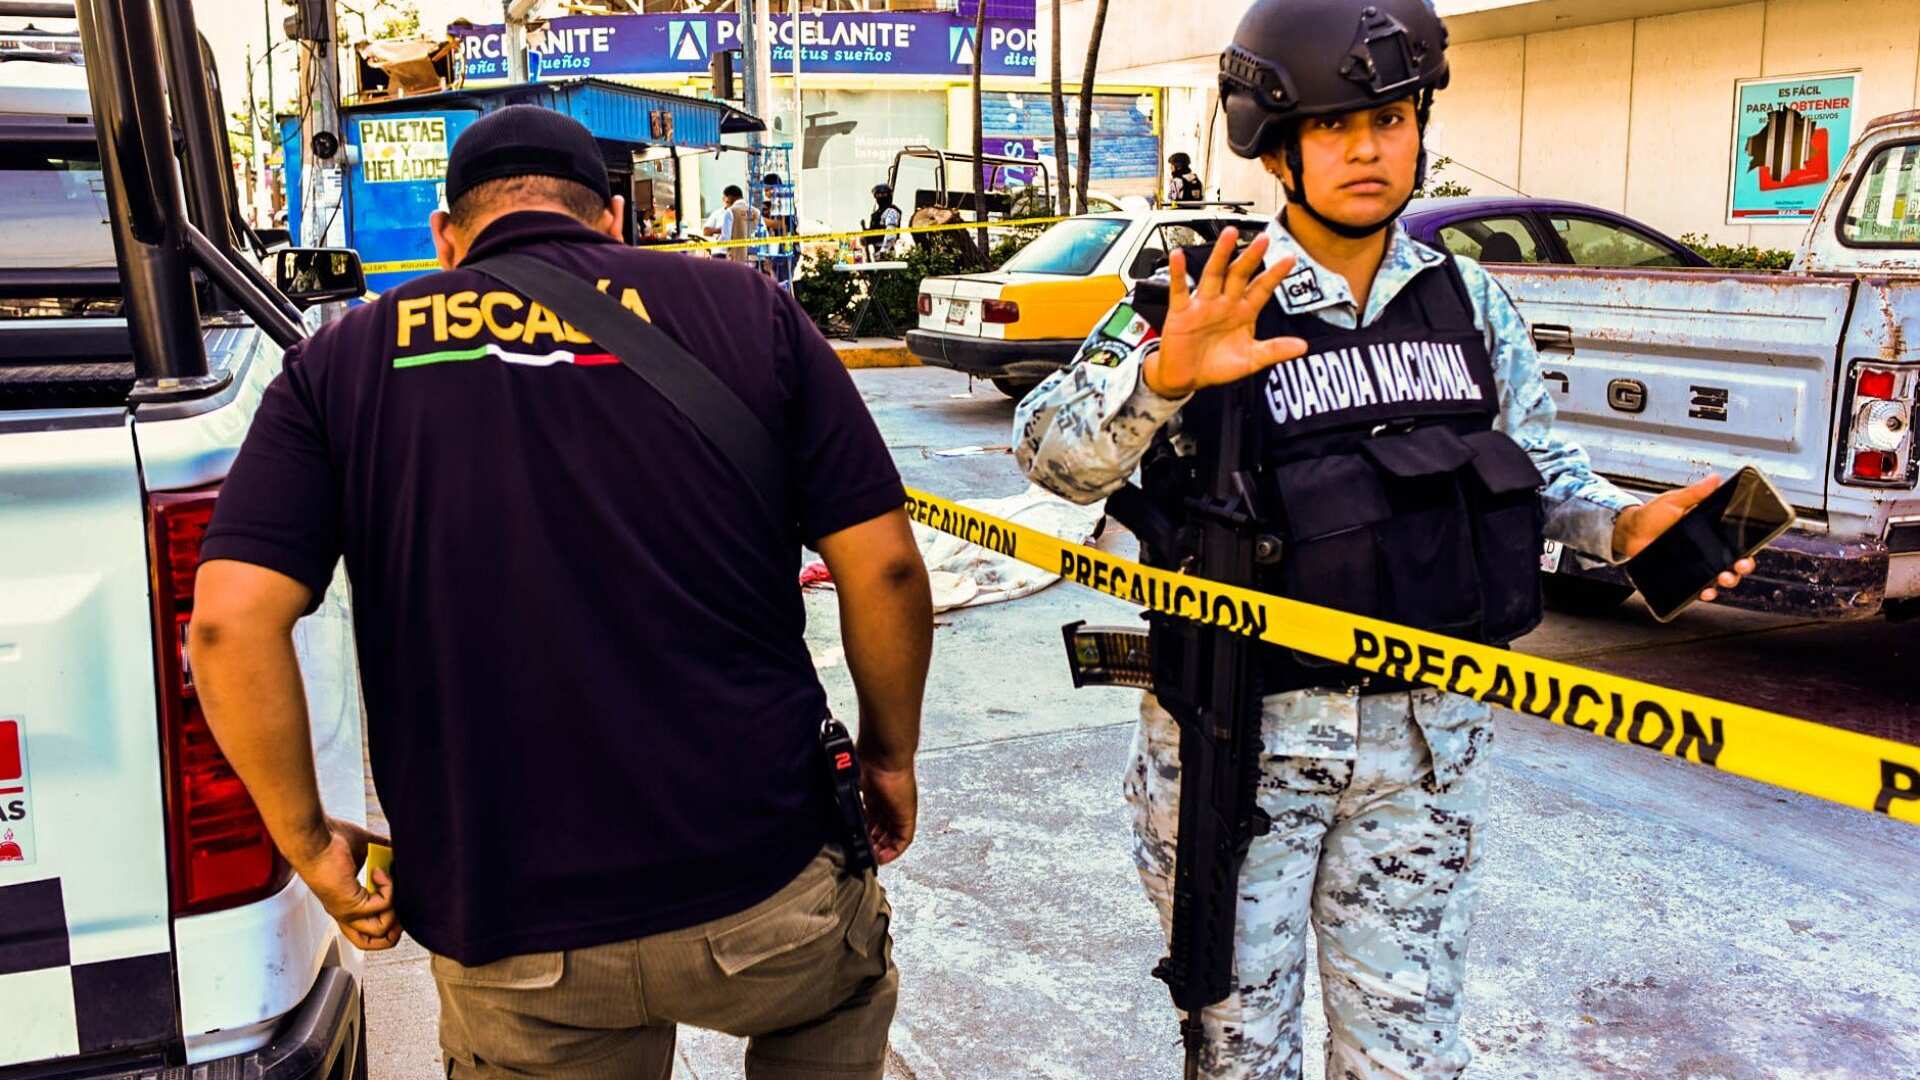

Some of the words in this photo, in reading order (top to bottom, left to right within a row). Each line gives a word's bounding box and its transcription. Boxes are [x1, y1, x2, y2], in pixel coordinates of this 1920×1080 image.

[834, 46, 892, 62] sueños
[1778, 88, 1790, 98] ES
[1792, 84, 1821, 96] FÁCIL
[1746, 104, 1774, 113] PARA
[1789, 97, 1849, 111] OBTENER
[361, 120, 444, 143] PALETAS
[400, 143, 411, 156] Y
[364, 158, 449, 182] HELADOS
[1265, 346, 1378, 424] GUARDIA
[1369, 341, 1482, 404] NACIONAL
[905, 496, 1017, 558] RECAUCION
[1061, 549, 1267, 635] PRECAUCION
[1348, 628, 1724, 767] PRECAUCION
